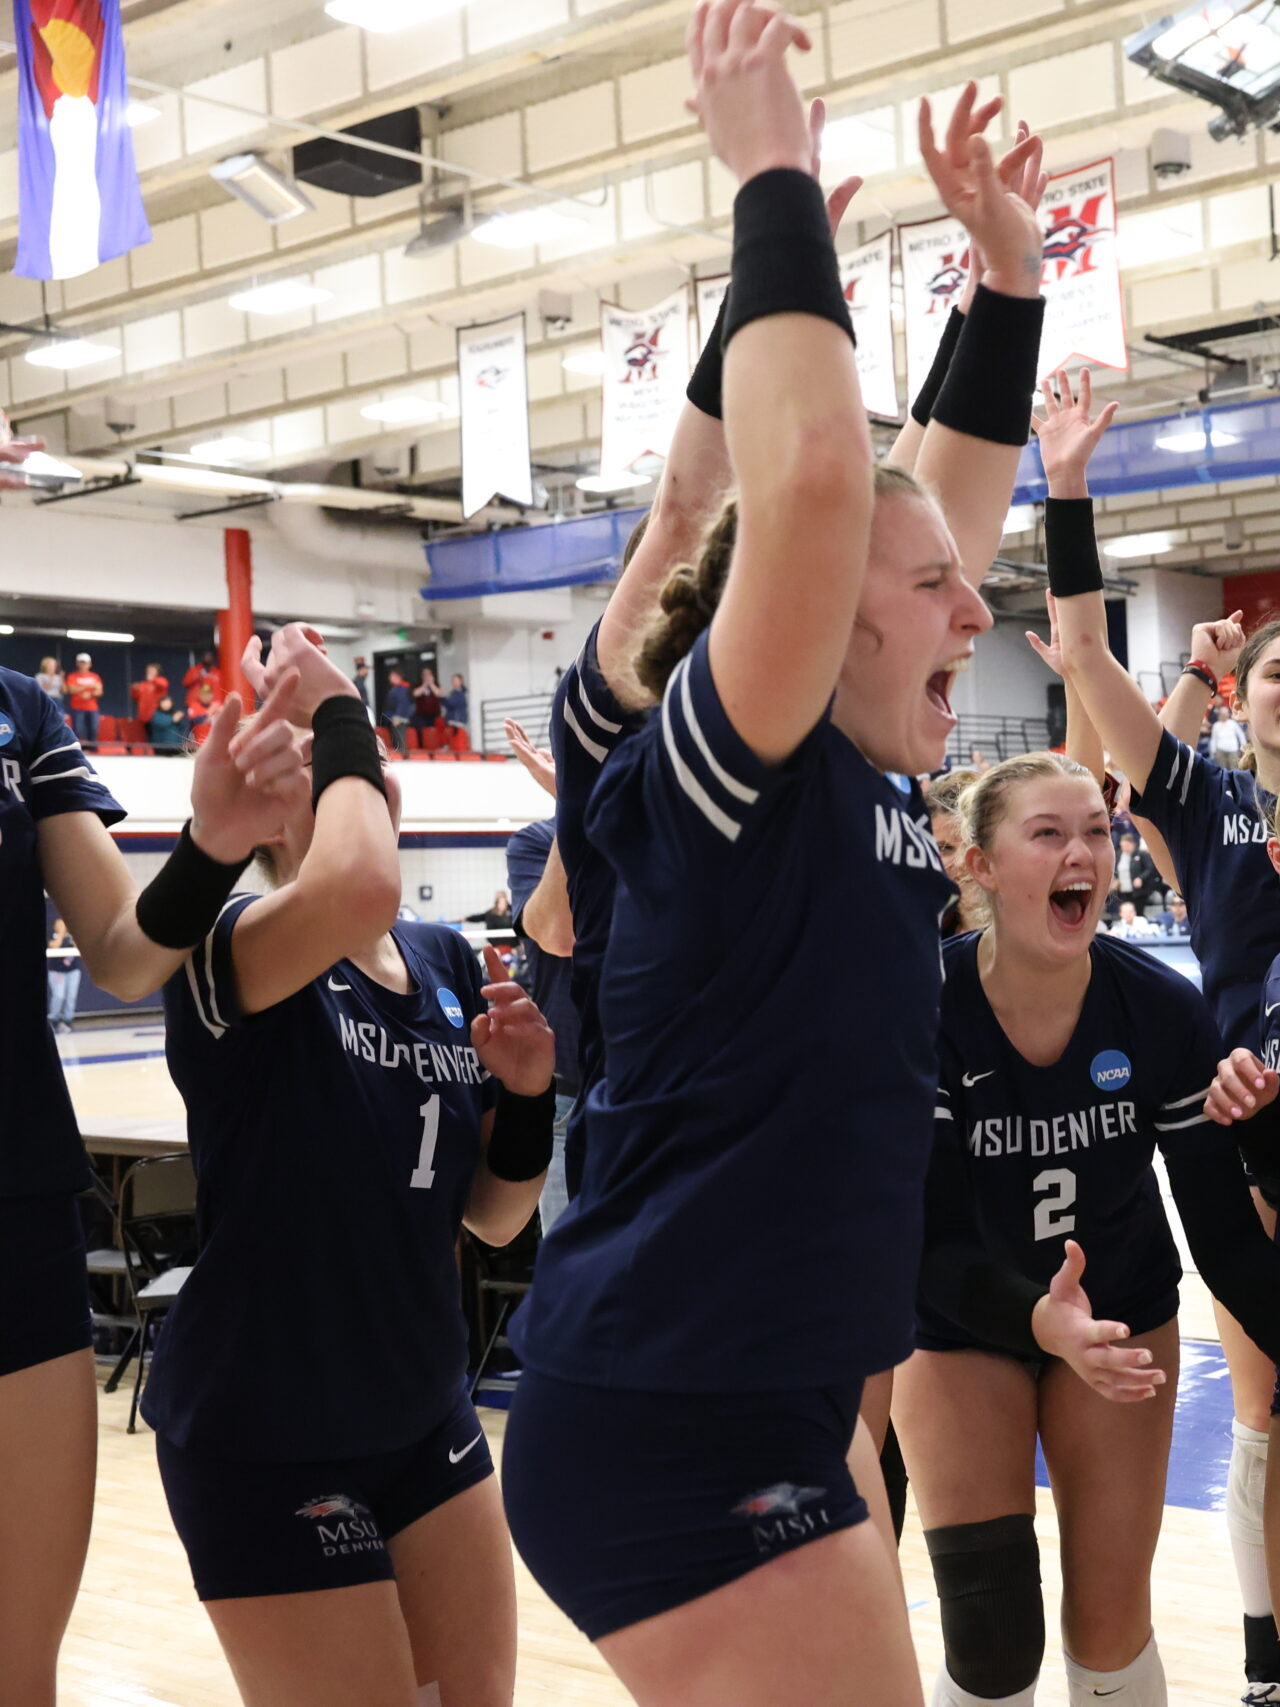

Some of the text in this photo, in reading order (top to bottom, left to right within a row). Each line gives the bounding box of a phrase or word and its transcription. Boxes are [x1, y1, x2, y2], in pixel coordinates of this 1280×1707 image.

[1069, 174, 1106, 196] STATE
[1223, 813, 1268, 846] MSU
[1097, 1066, 1130, 1083] NCAA
[409, 1093, 440, 1189] 1
[968, 1101, 1138, 1157] MSU DENVER
[1033, 1167, 1077, 1242] 2
[316, 1520, 378, 1544] MSU
